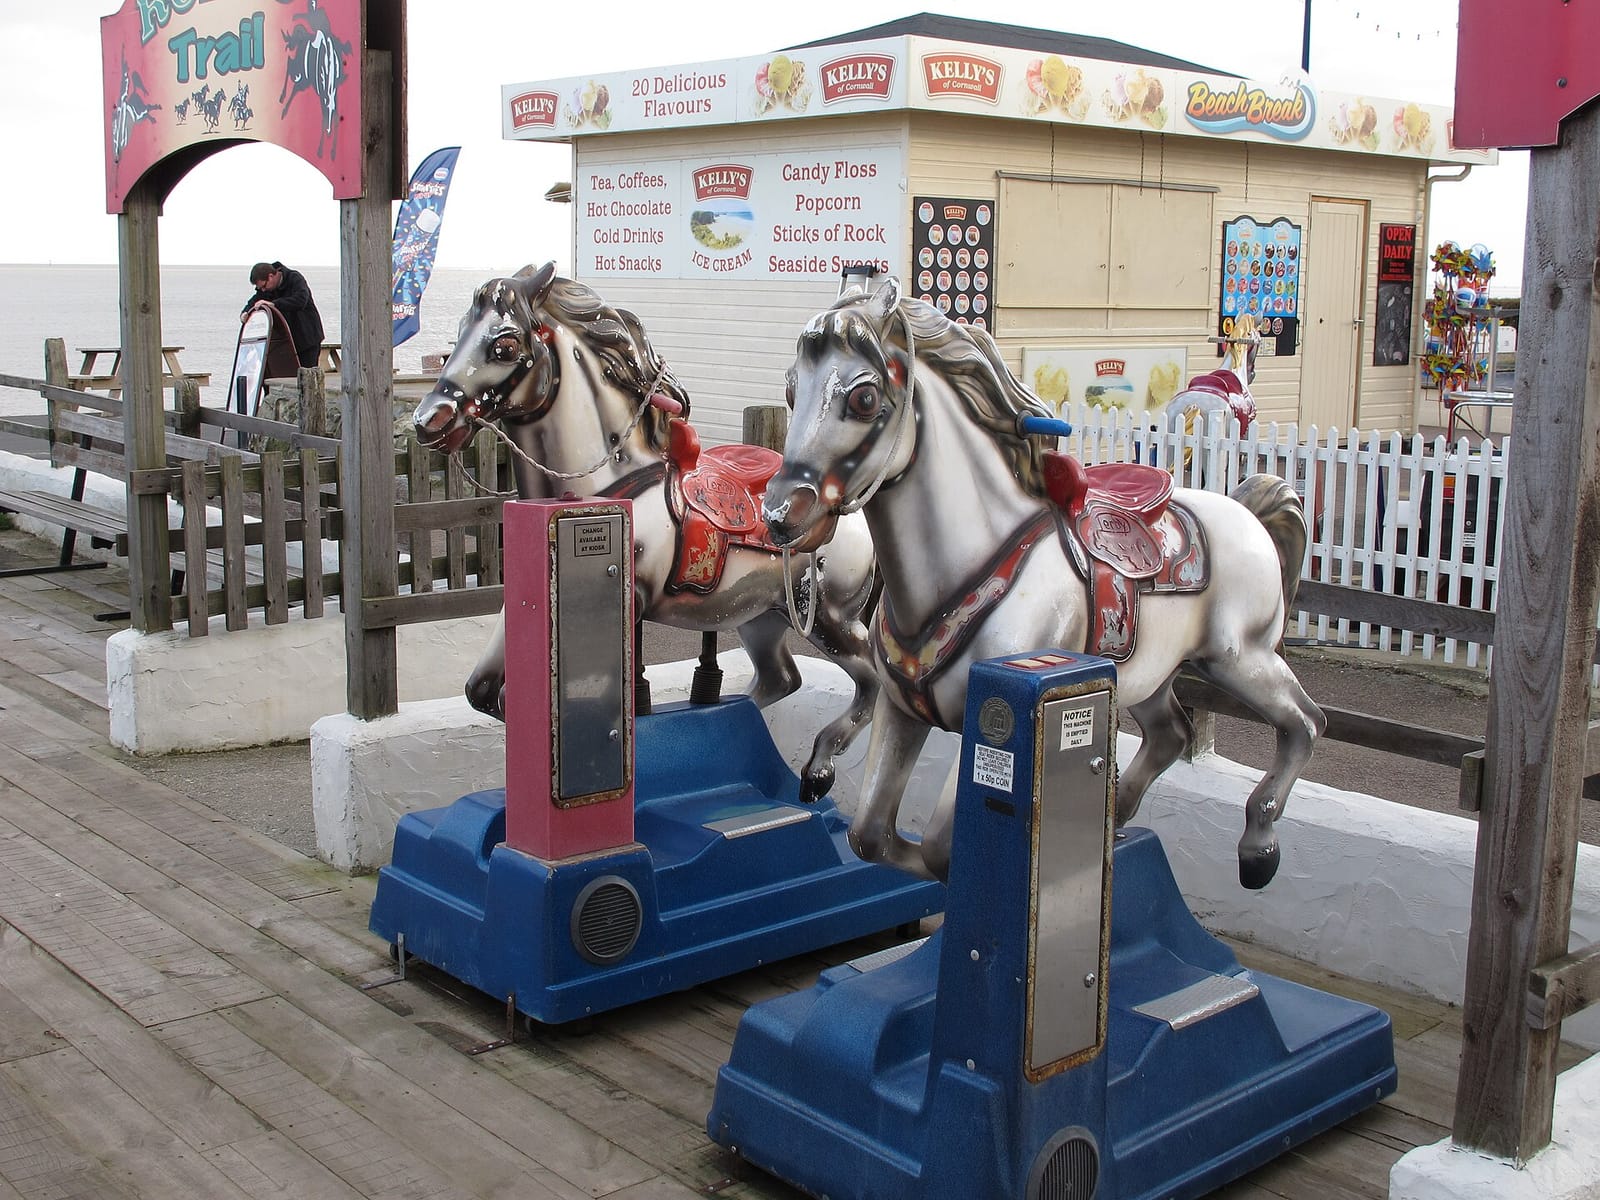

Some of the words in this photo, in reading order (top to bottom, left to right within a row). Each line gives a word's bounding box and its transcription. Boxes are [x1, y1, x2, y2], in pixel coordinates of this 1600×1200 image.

[169, 12, 264, 83] Trail
[826, 62, 887, 87] KELLY'S
[930, 61, 995, 86] KELLY'S
[632, 78, 650, 96] 20
[654, 72, 726, 94] Delicious
[837, 83, 845, 94] of
[846, 82, 875, 91] Cornwall
[942, 80, 950, 89] of
[514, 98, 554, 117] KELLY'S
[644, 98, 712, 118] Flavours
[1188, 80, 1248, 116] Beach
[1247, 88, 1303, 124] Break
[590, 175, 615, 192] Tea,
[618, 172, 667, 190] Coffees,
[698, 170, 747, 189] KELLY'S
[782, 162, 830, 185] Candy
[834, 161, 877, 179] Floss
[587, 202, 608, 217] Hot
[610, 200, 672, 217] Chocolate
[795, 194, 861, 216] Popcorn
[594, 228, 620, 244] Cold
[623, 227, 664, 244] Drinks
[773, 225, 820, 244] Sticks
[824, 223, 841, 242] of
[844, 224, 886, 244] Rock
[1387, 227, 1412, 241] OPEN
[692, 250, 710, 270] ICE
[712, 248, 753, 272] CREAM
[1384, 245, 1413, 259] DAILY
[595, 255, 616, 270] Hot
[618, 255, 662, 272] Snacks
[768, 256, 827, 273] Seaside
[1064, 710, 1092, 720] NOTICE
